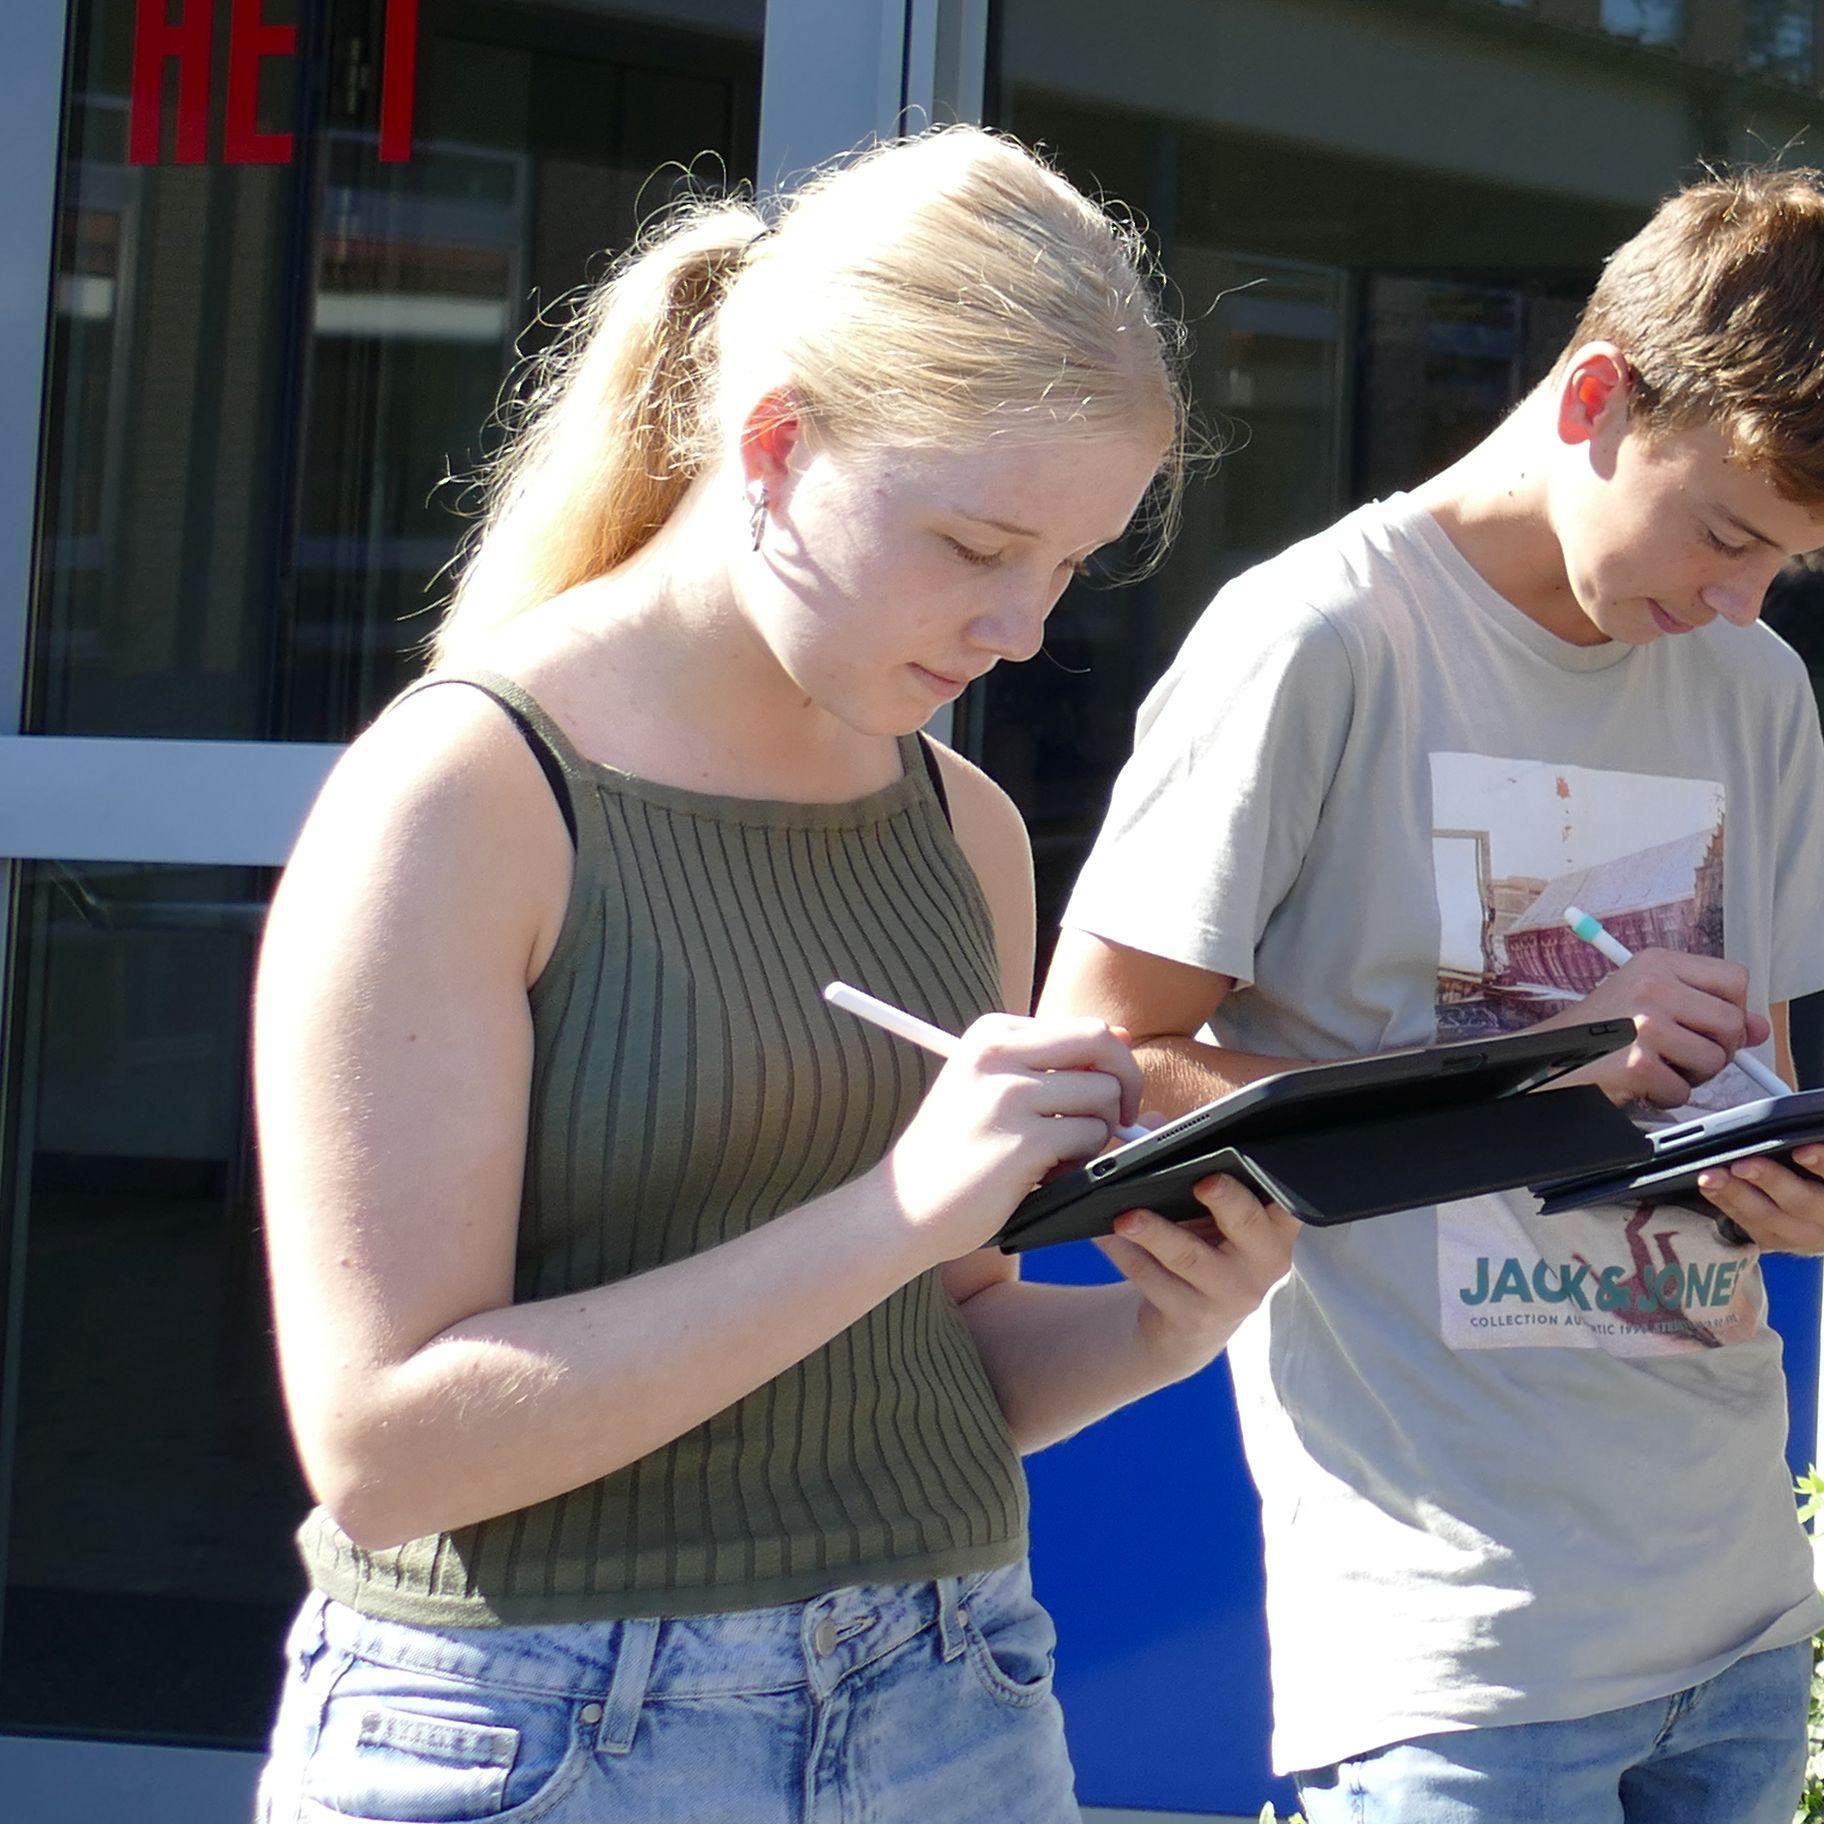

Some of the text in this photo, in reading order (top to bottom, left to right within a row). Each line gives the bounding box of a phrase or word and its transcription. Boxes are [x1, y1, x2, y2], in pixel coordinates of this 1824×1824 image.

[1460, 1257, 1592, 1311] JACK
[1595, 1266, 1631, 1312] &
[1470, 1314, 1558, 1327] COLLECTION
